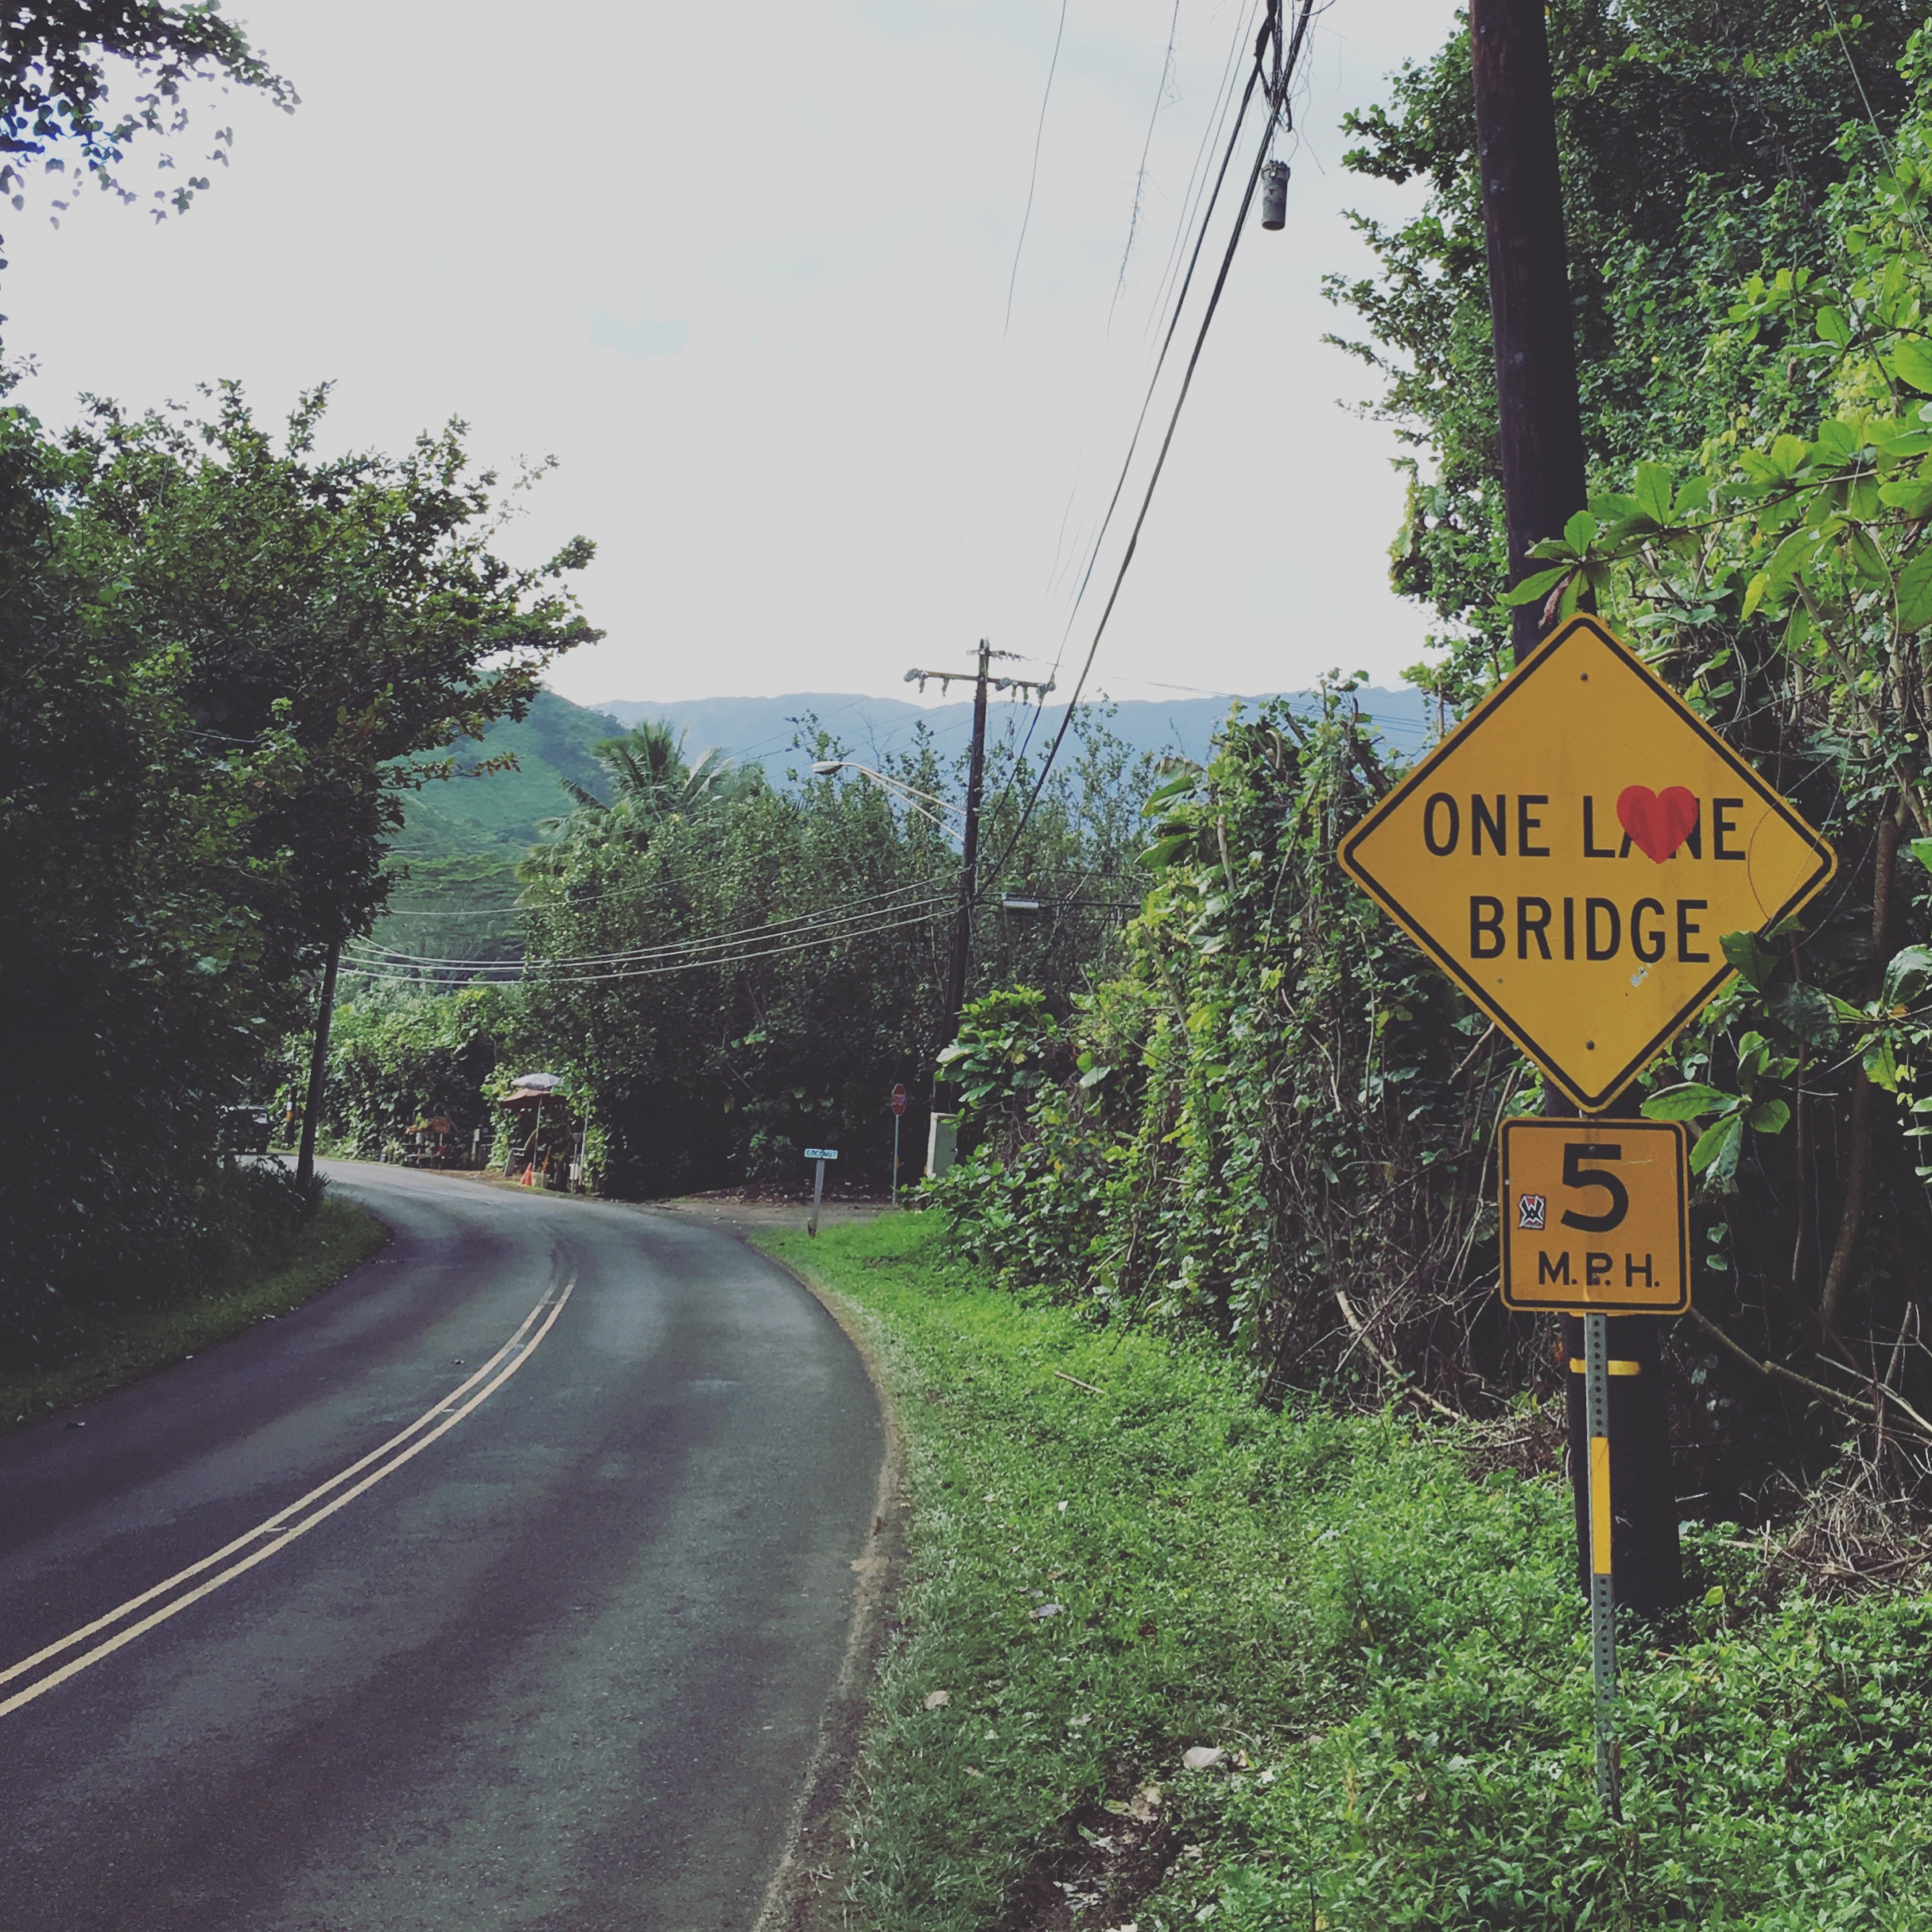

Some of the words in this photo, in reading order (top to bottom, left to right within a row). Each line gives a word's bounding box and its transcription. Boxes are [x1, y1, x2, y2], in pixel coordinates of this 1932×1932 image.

[1423, 793, 1550, 857] ONE
[1469, 895, 1710, 964] BRIDGE
[1561, 1143, 1628, 1232] 5
[1538, 1251, 1660, 1288] M.P.H.
